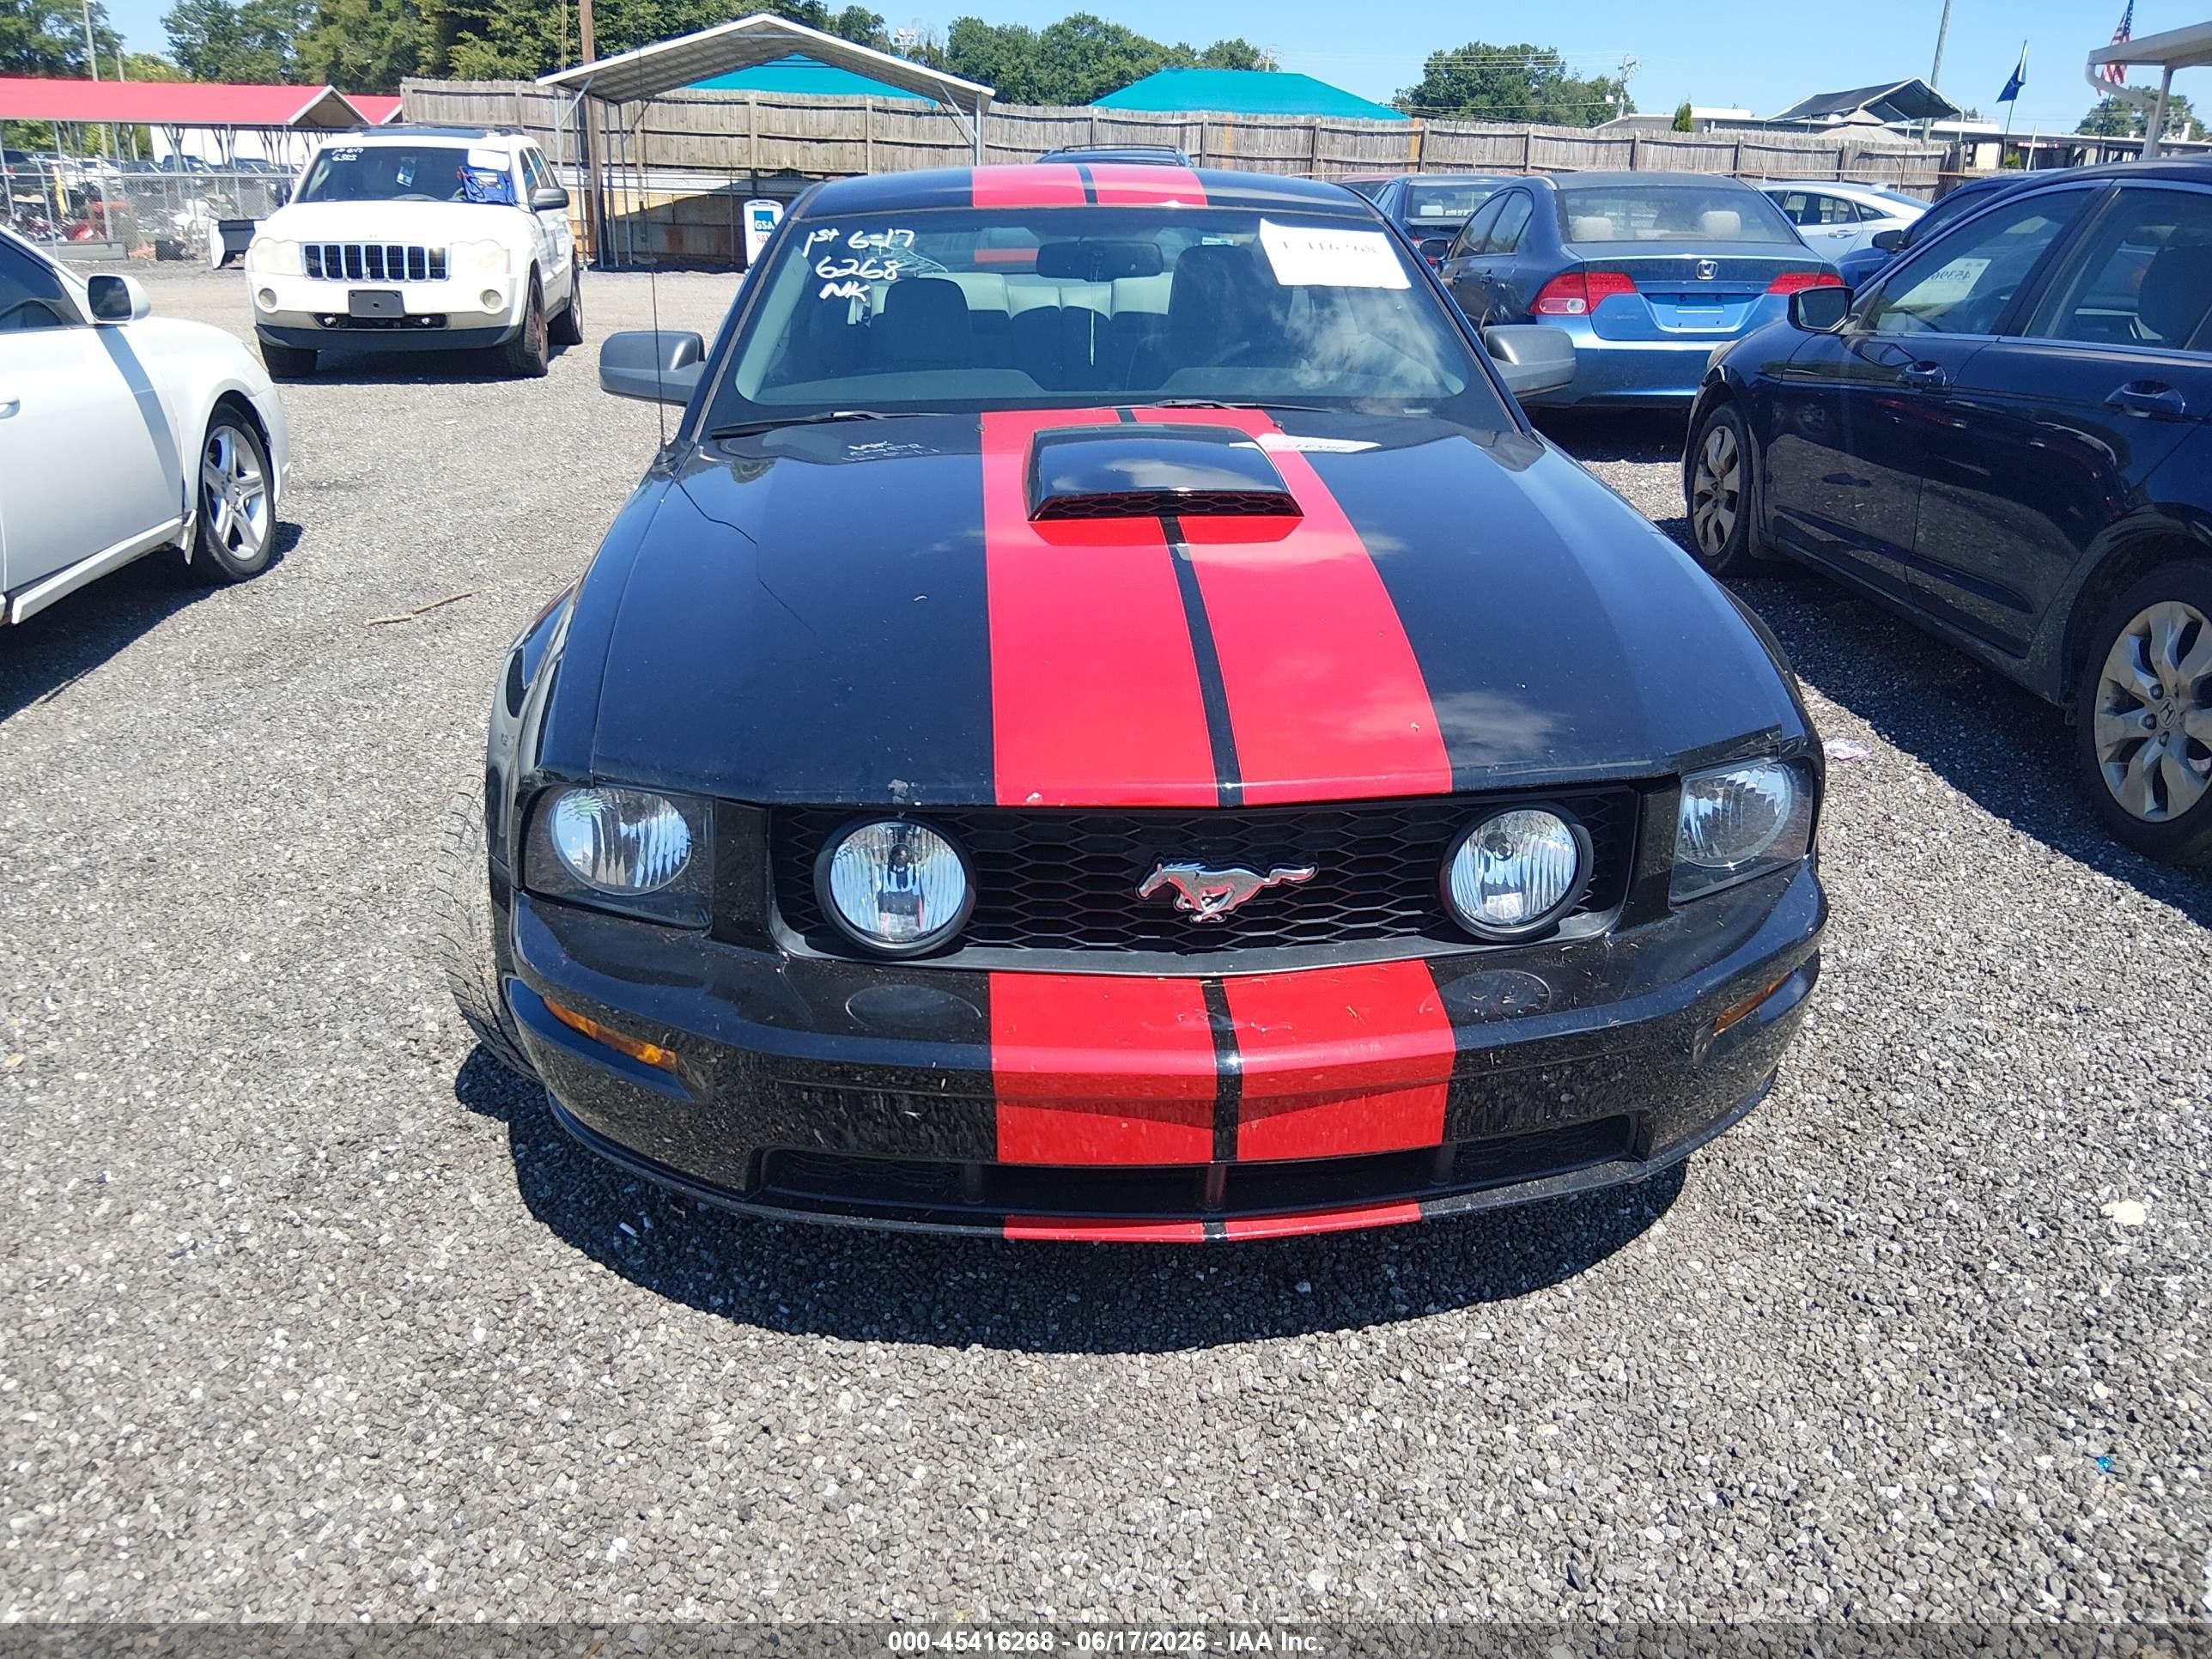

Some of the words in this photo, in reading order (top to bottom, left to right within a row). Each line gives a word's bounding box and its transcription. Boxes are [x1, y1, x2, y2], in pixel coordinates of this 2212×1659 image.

[755, 220, 775, 230] GSA
[802, 228, 840, 258] 1st
[848, 228, 915, 249] 6-17
[815, 256, 900, 281] 6268
[819, 281, 870, 301] NK
